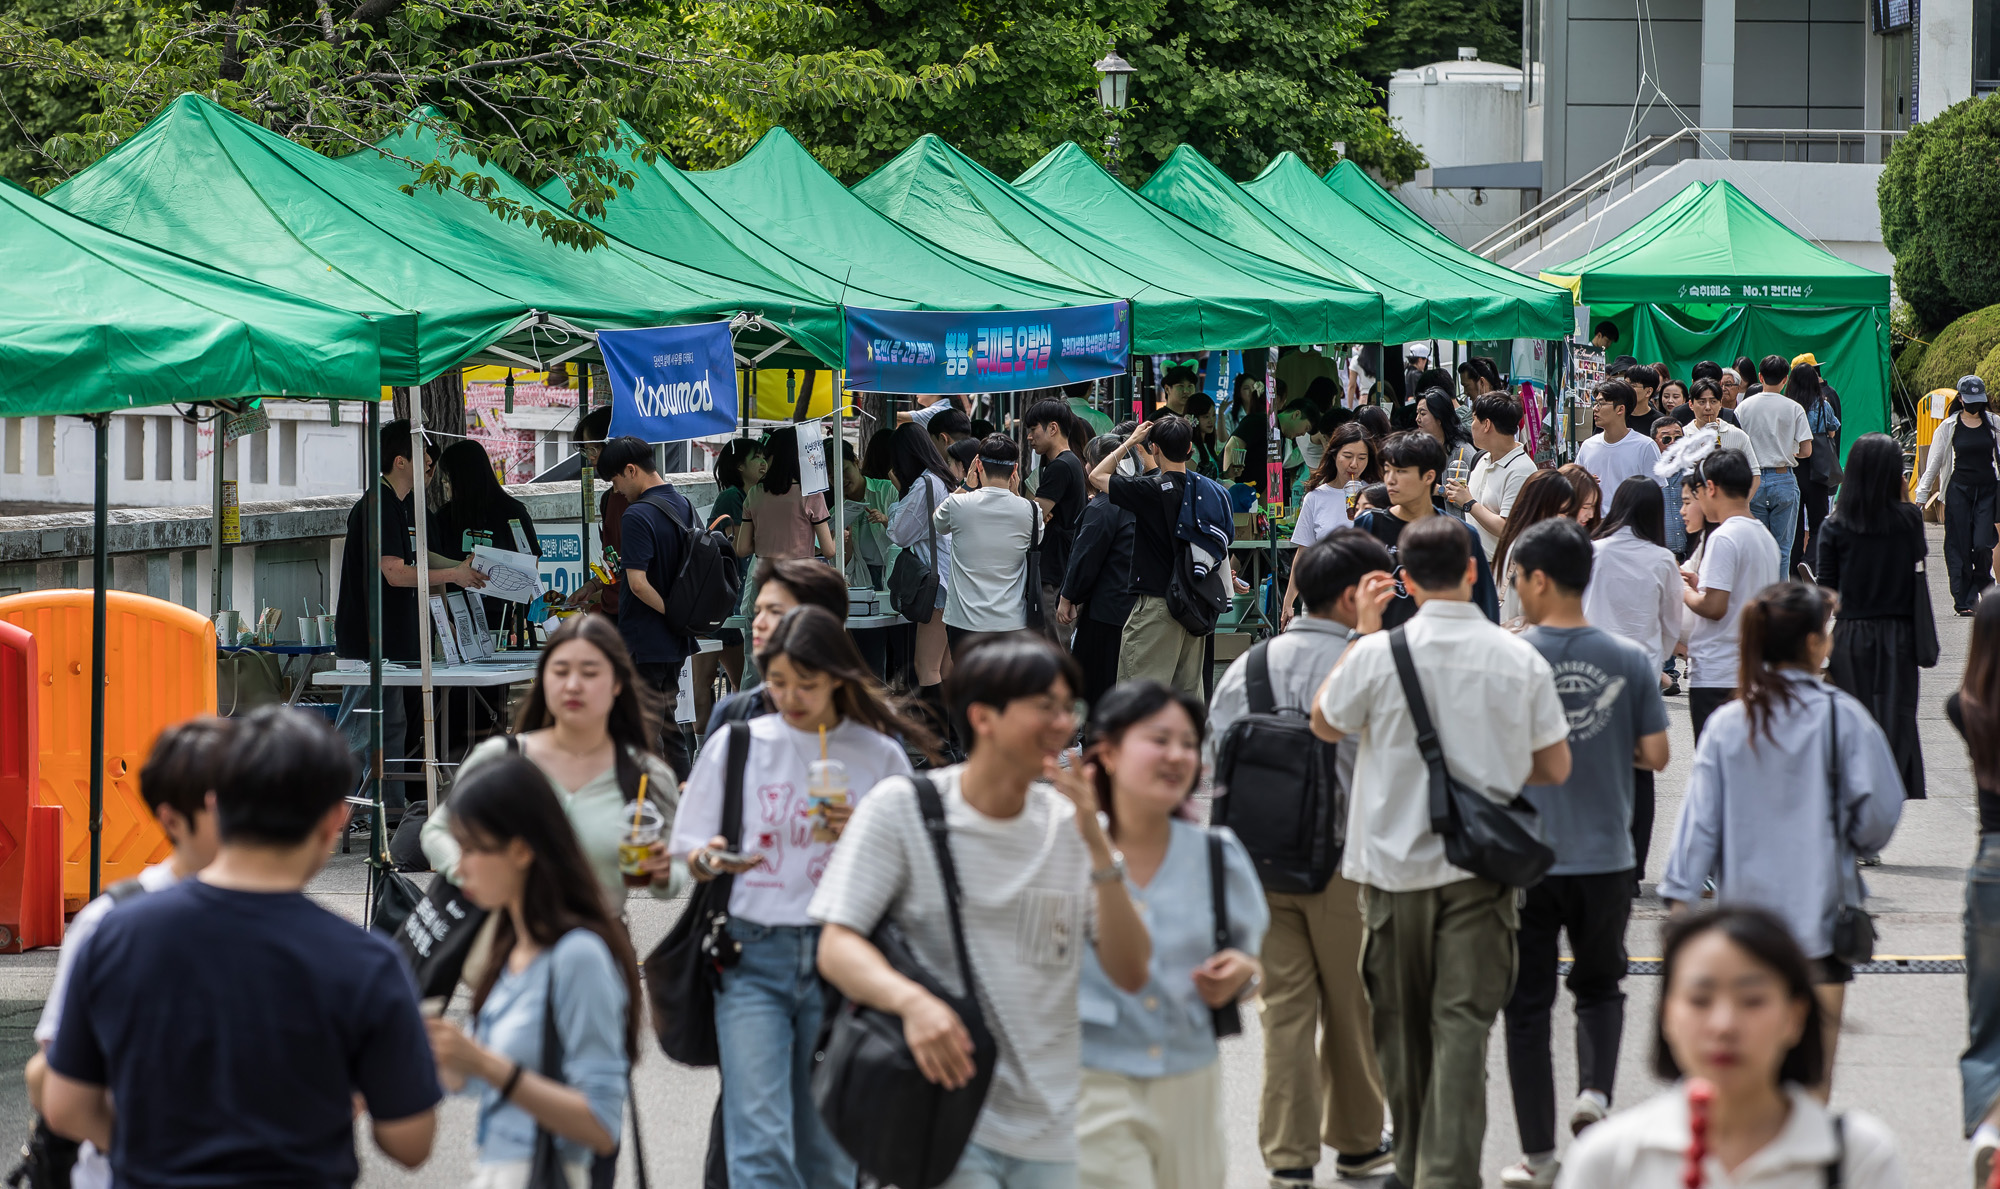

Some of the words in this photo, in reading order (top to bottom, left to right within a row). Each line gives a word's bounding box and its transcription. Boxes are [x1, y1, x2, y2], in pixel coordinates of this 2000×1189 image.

[1689, 285, 1731, 296] 숙취해소
[1743, 285, 1768, 296] No.1
[1771, 285, 1801, 297] 컨디션
[976, 327, 1013, 374] 큐피트
[1014, 323, 1052, 372] 오락실
[634, 369, 714, 418] Knowmad
[541, 538, 557, 558] 편입학
[558, 538, 579, 558] 사관학교
